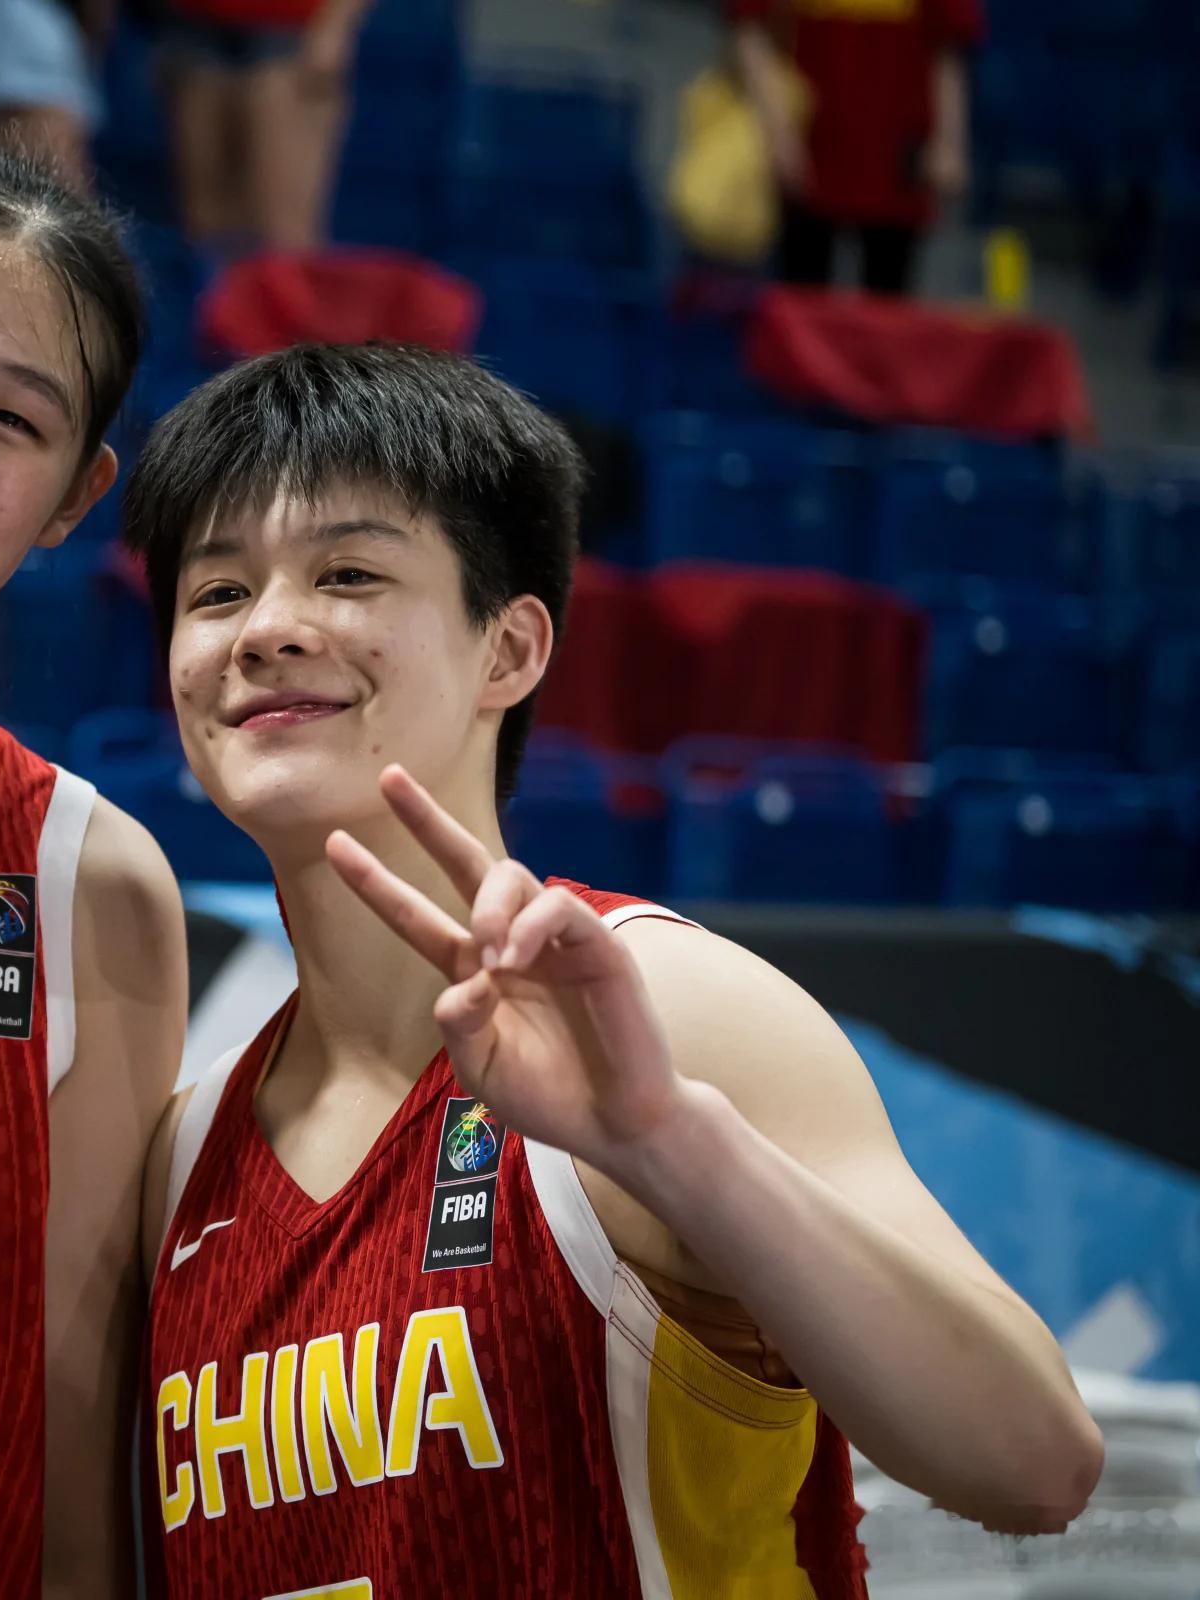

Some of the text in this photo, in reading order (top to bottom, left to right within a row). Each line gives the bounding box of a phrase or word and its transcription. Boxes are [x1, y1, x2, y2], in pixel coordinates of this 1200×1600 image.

[441, 1191, 487, 1224] FIBA
[432, 1242, 486, 1258] We Are Basketball
[157, 1305, 504, 1534] CHINA
